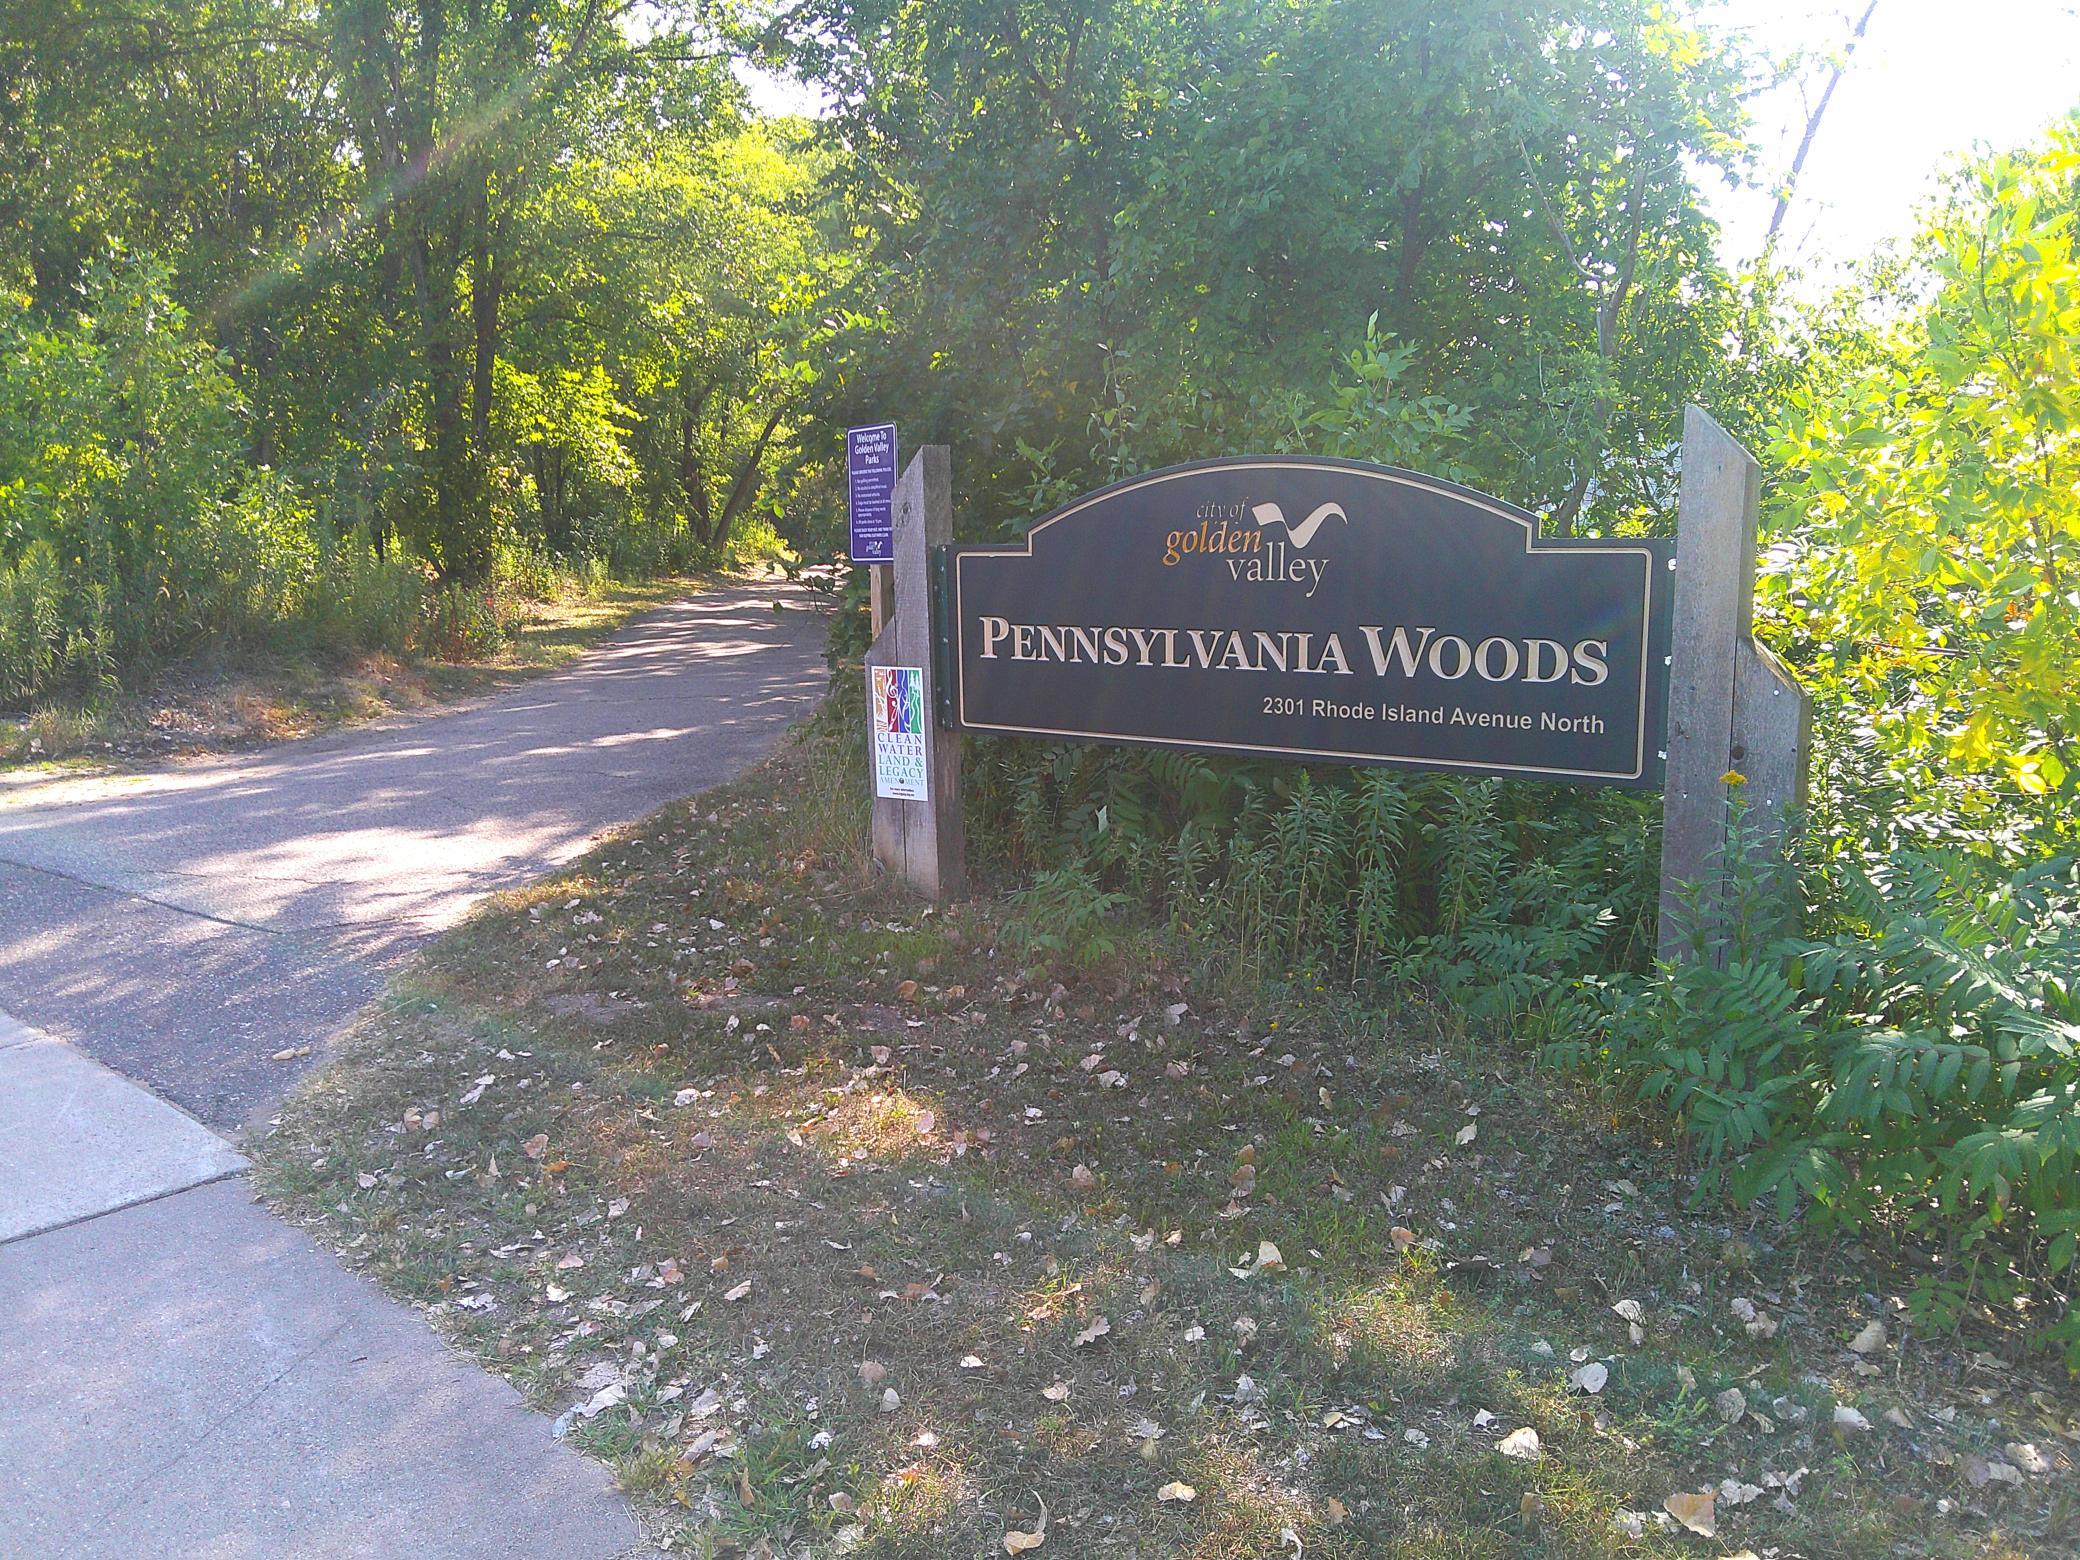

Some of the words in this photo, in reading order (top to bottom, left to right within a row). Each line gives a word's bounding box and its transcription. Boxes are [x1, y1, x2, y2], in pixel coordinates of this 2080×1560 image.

[856, 433, 880, 444] Welcome
[880, 431, 887, 440] To
[854, 444, 874, 455] Golden
[874, 441, 889, 453] Valley
[865, 454, 880, 465] Parks
[1196, 501, 1226, 519] city
[1229, 496, 1249, 521] of
[1162, 520, 1263, 567] golden
[1226, 541, 1330, 598] valley
[979, 616, 1354, 675] PENNSYLVANIA
[1359, 625, 1610, 686] WOODS
[1263, 697, 1304, 716] 2301
[1312, 700, 1376, 721] Rhode
[1382, 703, 1444, 725] Island
[1449, 709, 1533, 730] Avenue
[1540, 712, 1605, 734] North
[877, 733, 922, 744] CLEAN
[878, 744, 922, 755] WATER
[879, 755, 910, 766] LAND
[914, 757, 923, 768] &
[879, 766, 923, 778] LEGACY
